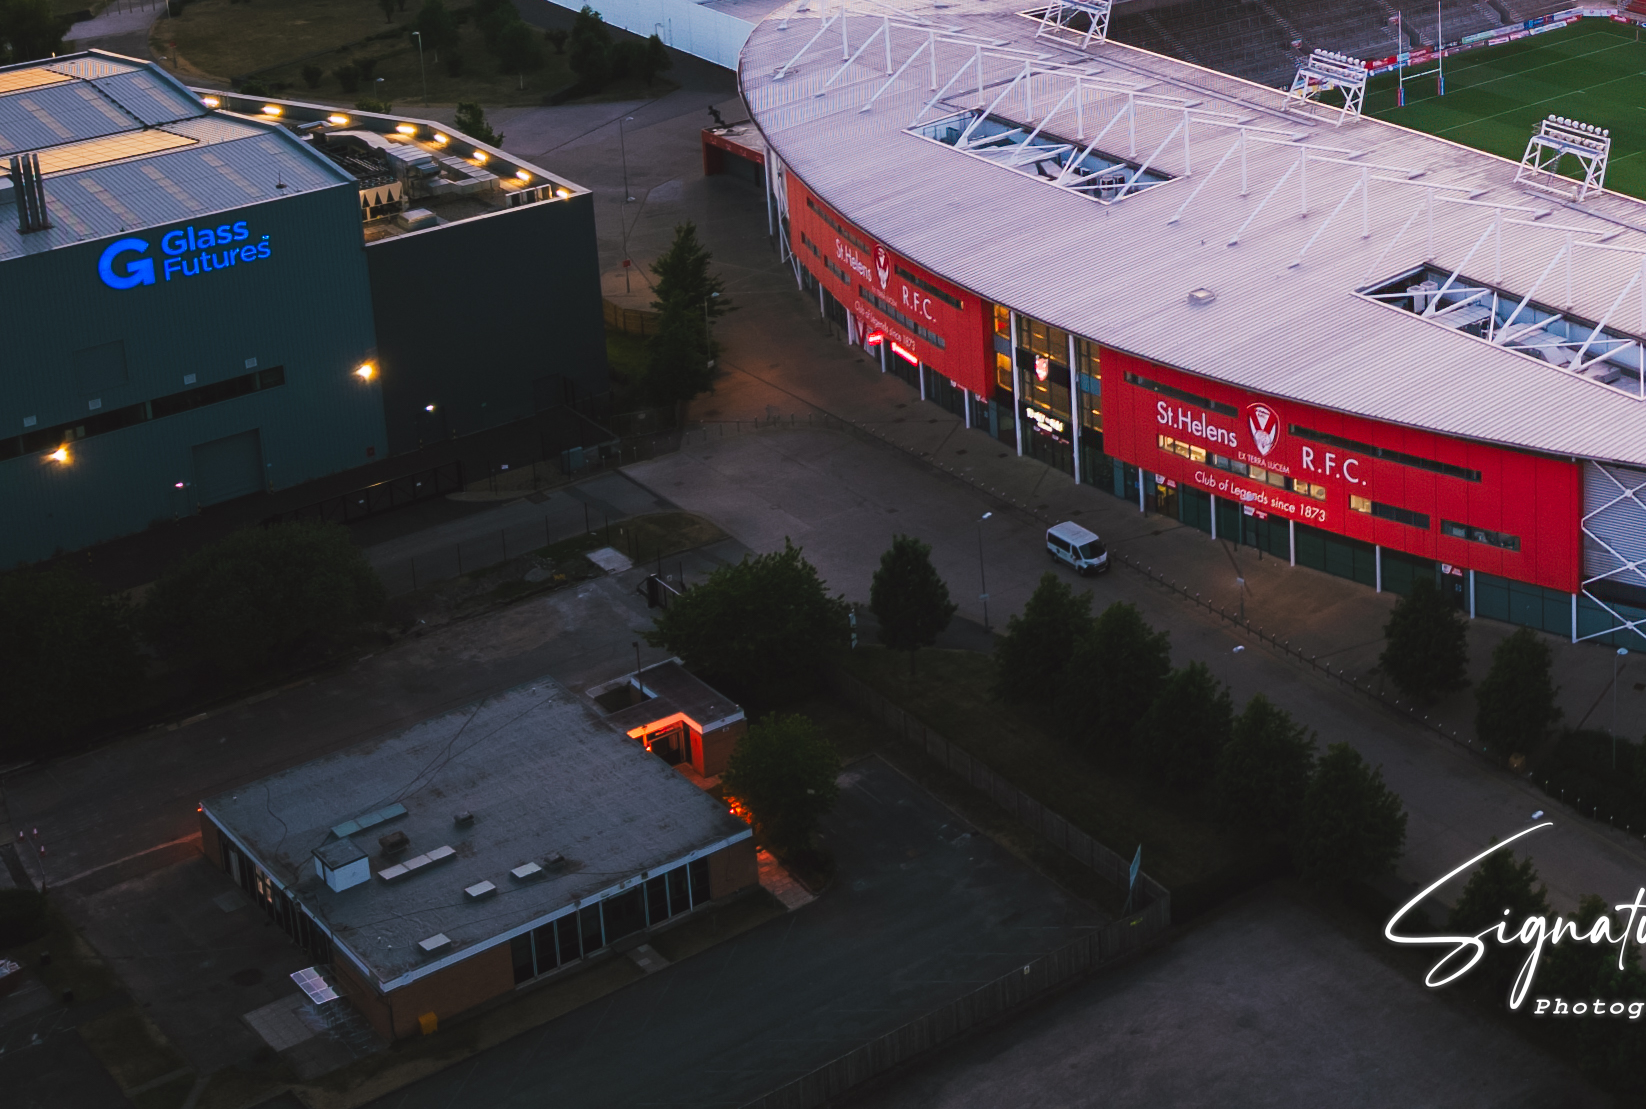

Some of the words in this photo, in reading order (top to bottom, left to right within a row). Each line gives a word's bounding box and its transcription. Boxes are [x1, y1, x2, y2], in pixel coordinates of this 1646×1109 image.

[161, 220, 249, 256] Glass
[98, 238, 156, 290] G
[163, 241, 271, 281] Futures
[902, 285, 937, 323] R.F.C.
[1247, 453, 1266, 467] TERRA
[1302, 446, 1367, 486] R.F.C.
[1194, 471, 1216, 488] Club
[1218, 479, 1229, 491] of
[1271, 496, 1296, 514] since
[1300, 503, 1326, 522] 1873
